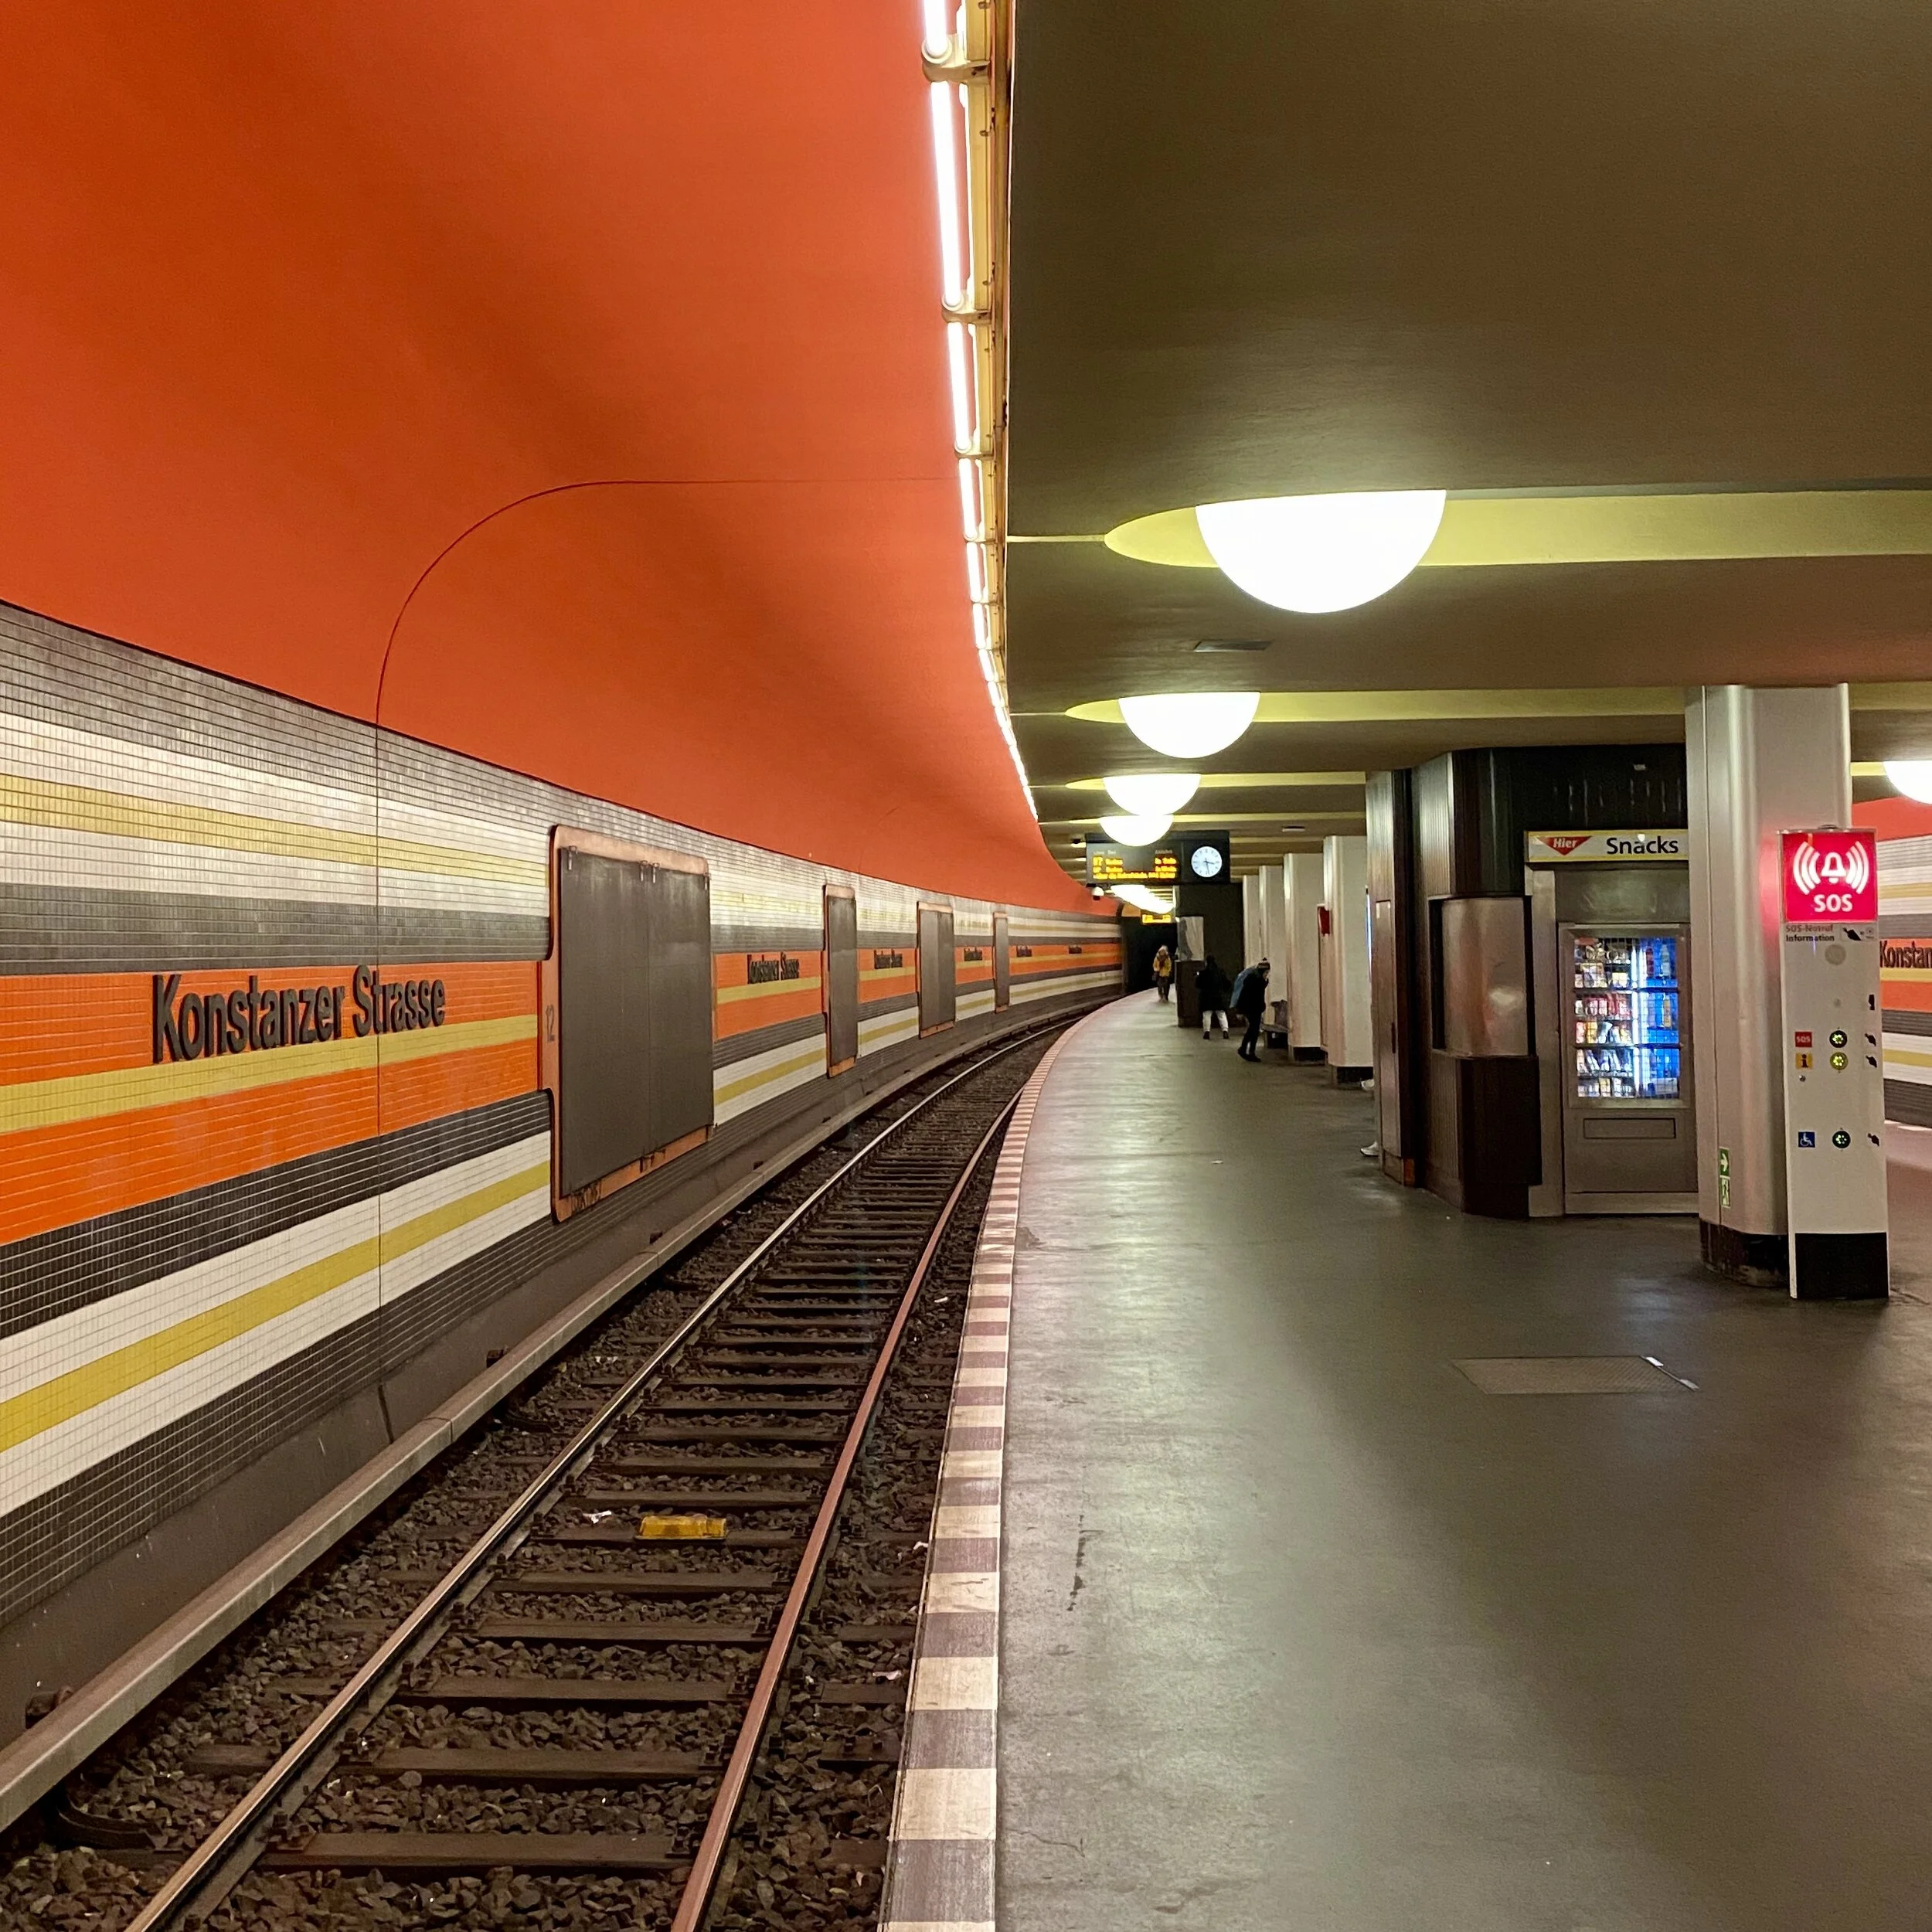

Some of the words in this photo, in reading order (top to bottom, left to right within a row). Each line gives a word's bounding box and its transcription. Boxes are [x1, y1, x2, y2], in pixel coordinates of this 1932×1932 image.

[1553, 838, 1577, 849] Hier
[1606, 835, 1679, 855] Snacks
[1814, 894, 1853, 913] SOS
[152, 974, 345, 1064] Konstanzer
[352, 964, 446, 1037] Strasse
